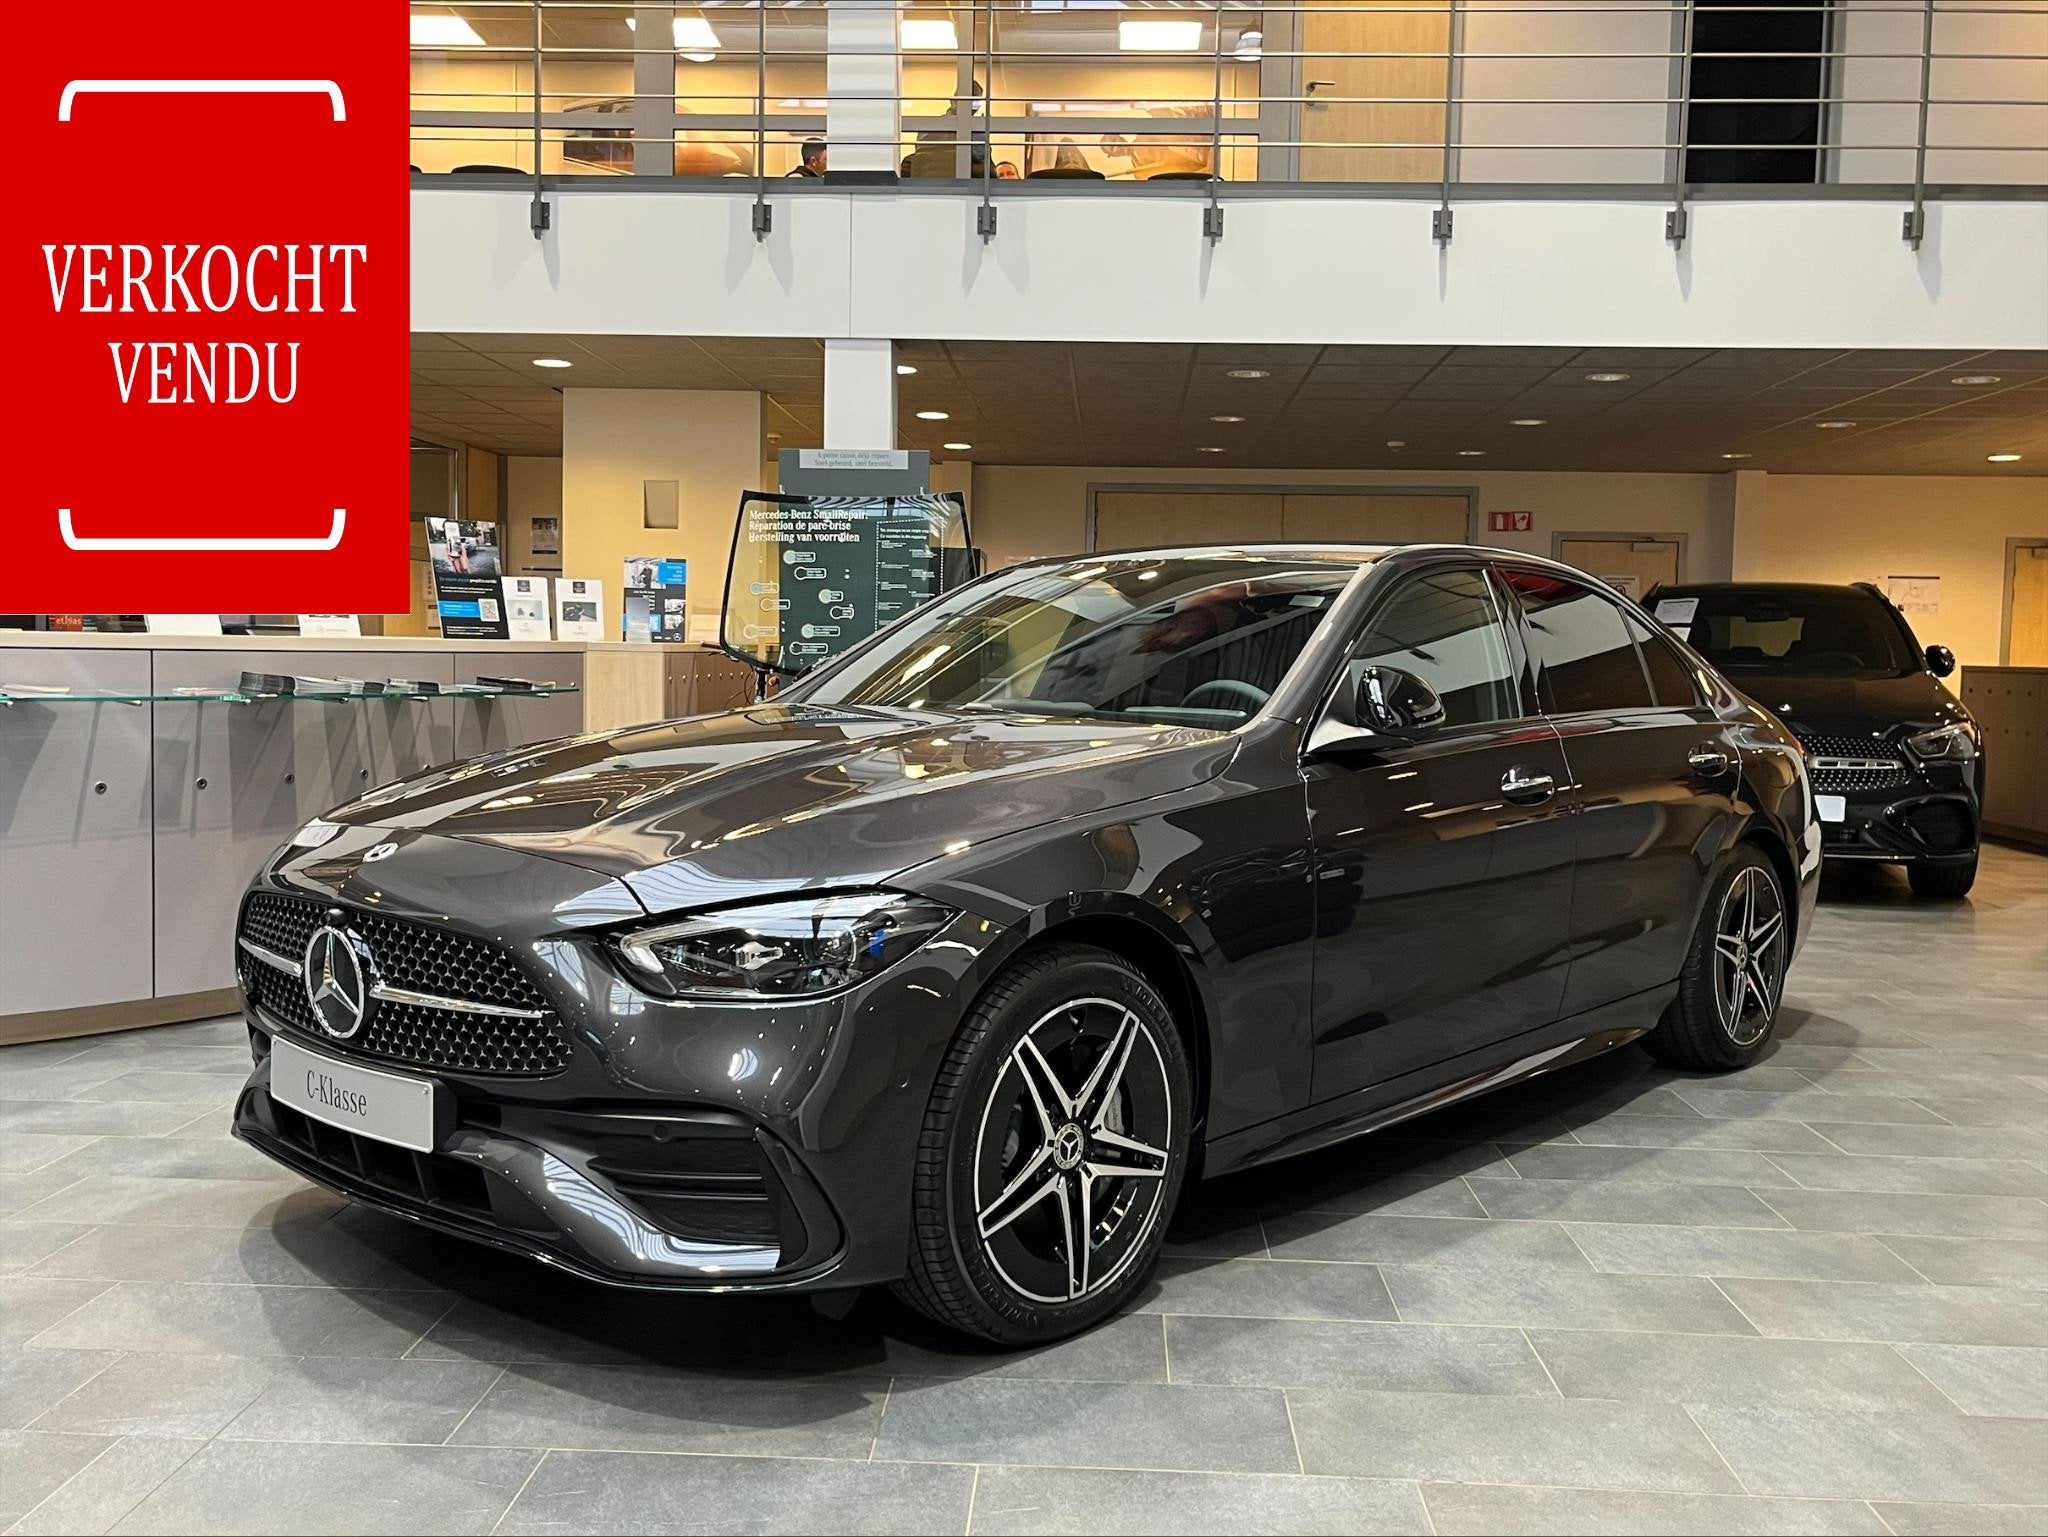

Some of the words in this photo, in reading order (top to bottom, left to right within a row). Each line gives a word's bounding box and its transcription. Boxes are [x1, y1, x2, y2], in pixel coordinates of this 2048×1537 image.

[749, 510, 812, 520] Mercedes-Benz
[749, 521, 794, 532] Réparation
[795, 521, 806, 531] de
[808, 521, 851, 532] parc-brise
[748, 532, 795, 543] Herstelling
[797, 533, 812, 542] van
[306, 1070, 367, 1116] C-Klasse
